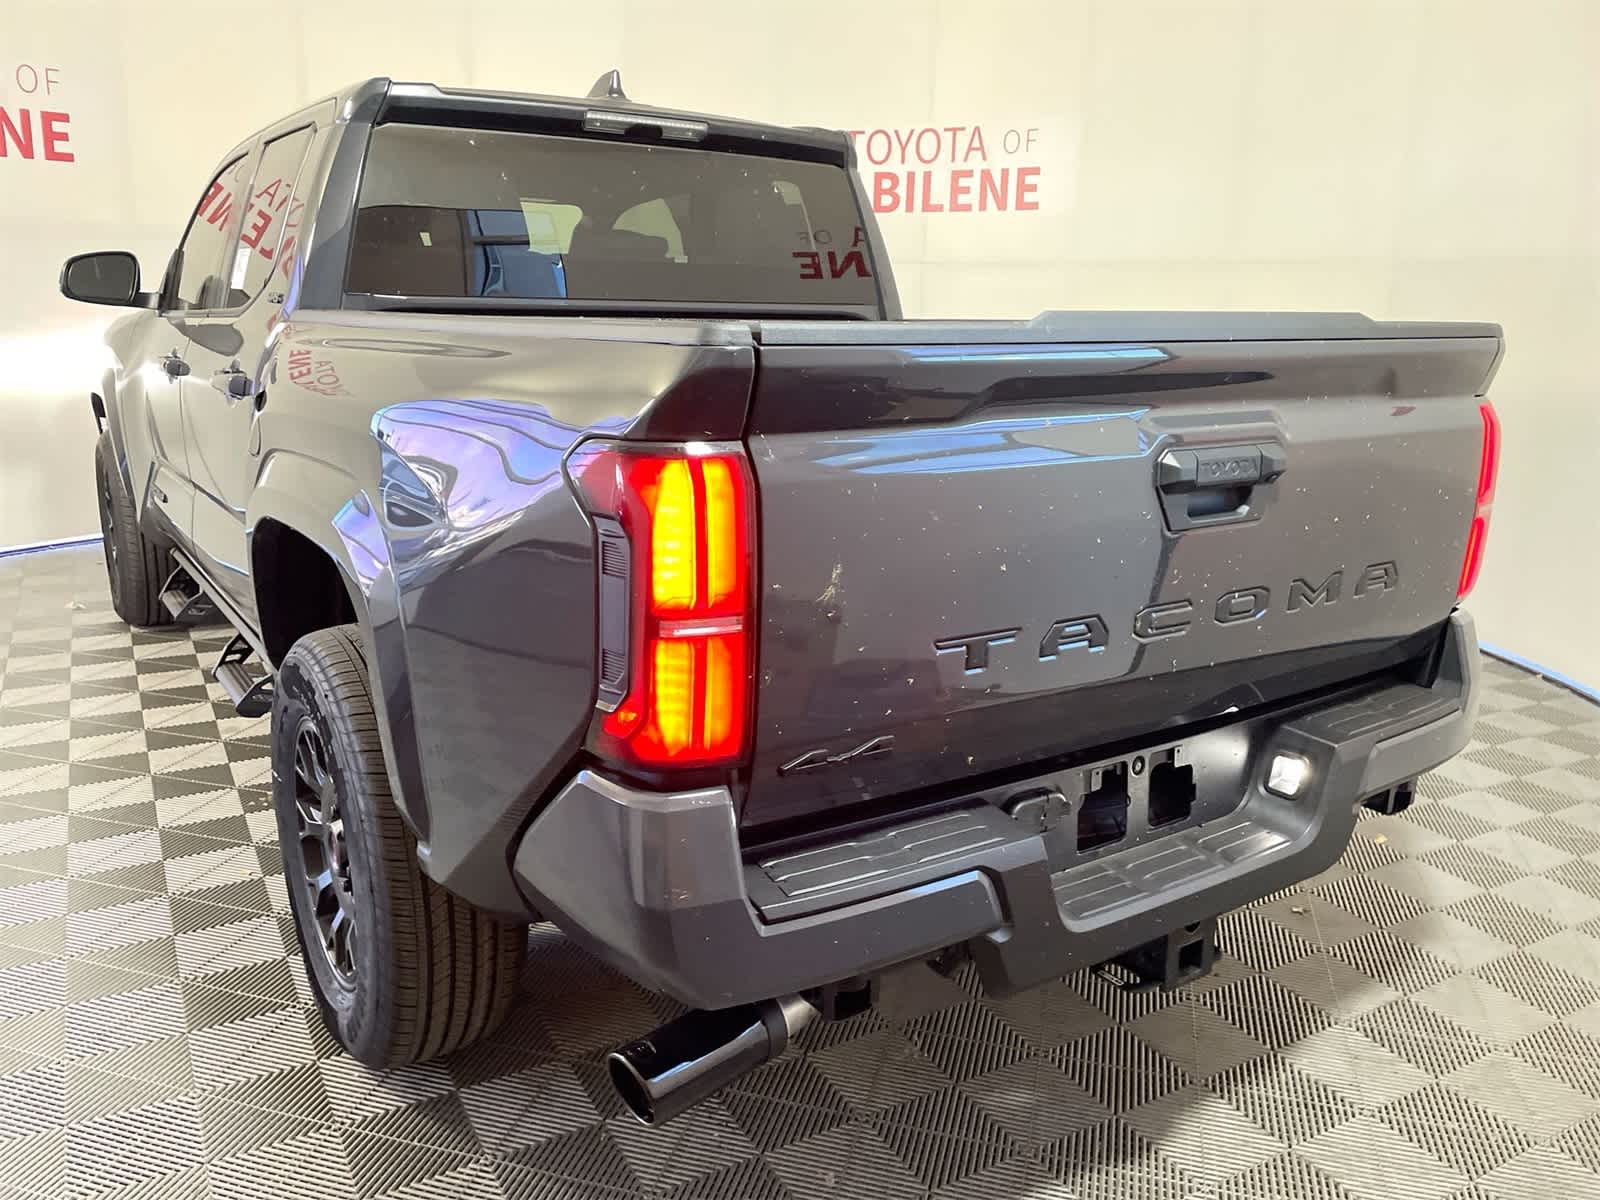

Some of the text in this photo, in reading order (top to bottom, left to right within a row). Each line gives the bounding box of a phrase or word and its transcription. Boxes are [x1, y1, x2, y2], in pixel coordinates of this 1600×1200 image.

[16, 63, 60, 95] OF
[1003, 128, 1039, 154] OF
[933, 560, 1399, 675] TACOMA
